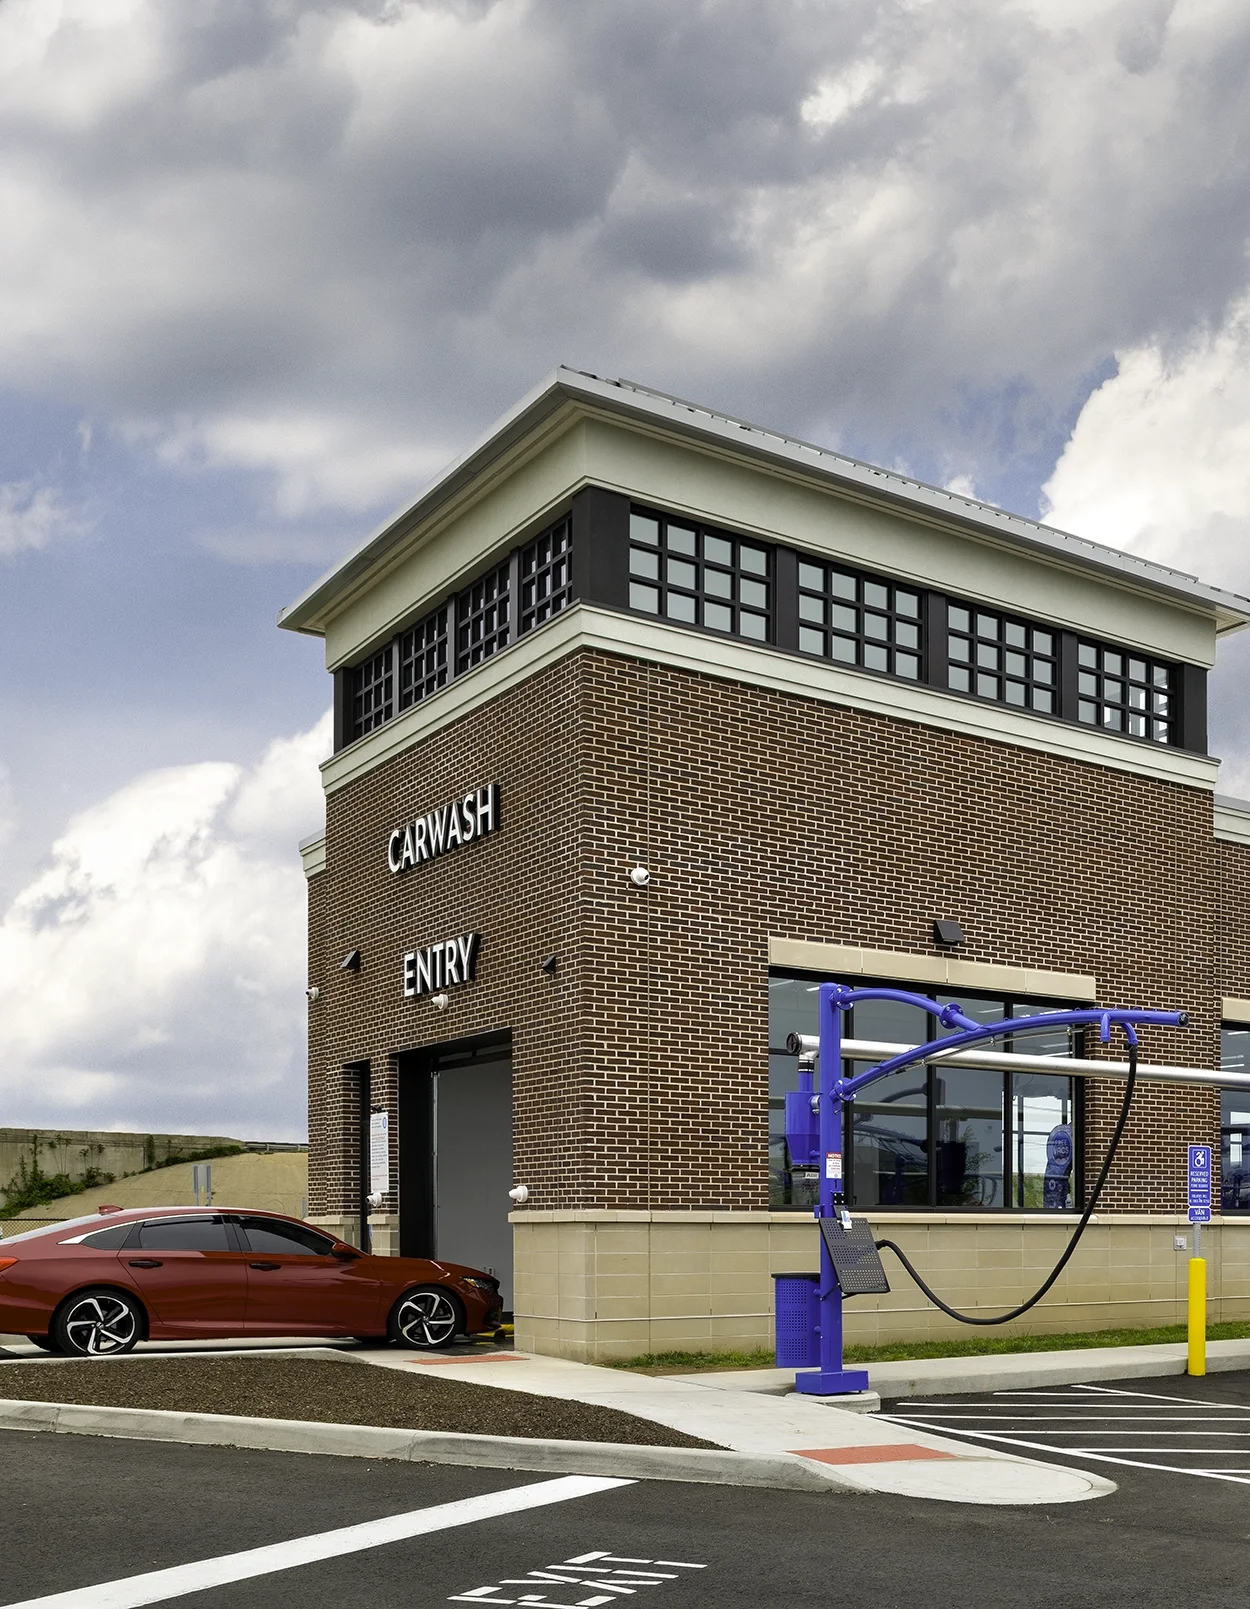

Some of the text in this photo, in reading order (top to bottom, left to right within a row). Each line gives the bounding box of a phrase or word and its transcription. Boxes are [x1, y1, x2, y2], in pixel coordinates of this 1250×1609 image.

[388, 783, 496, 873] CARWASH
[404, 933, 475, 997] ENTRY
[446, 1551, 708, 1609] EXIT
